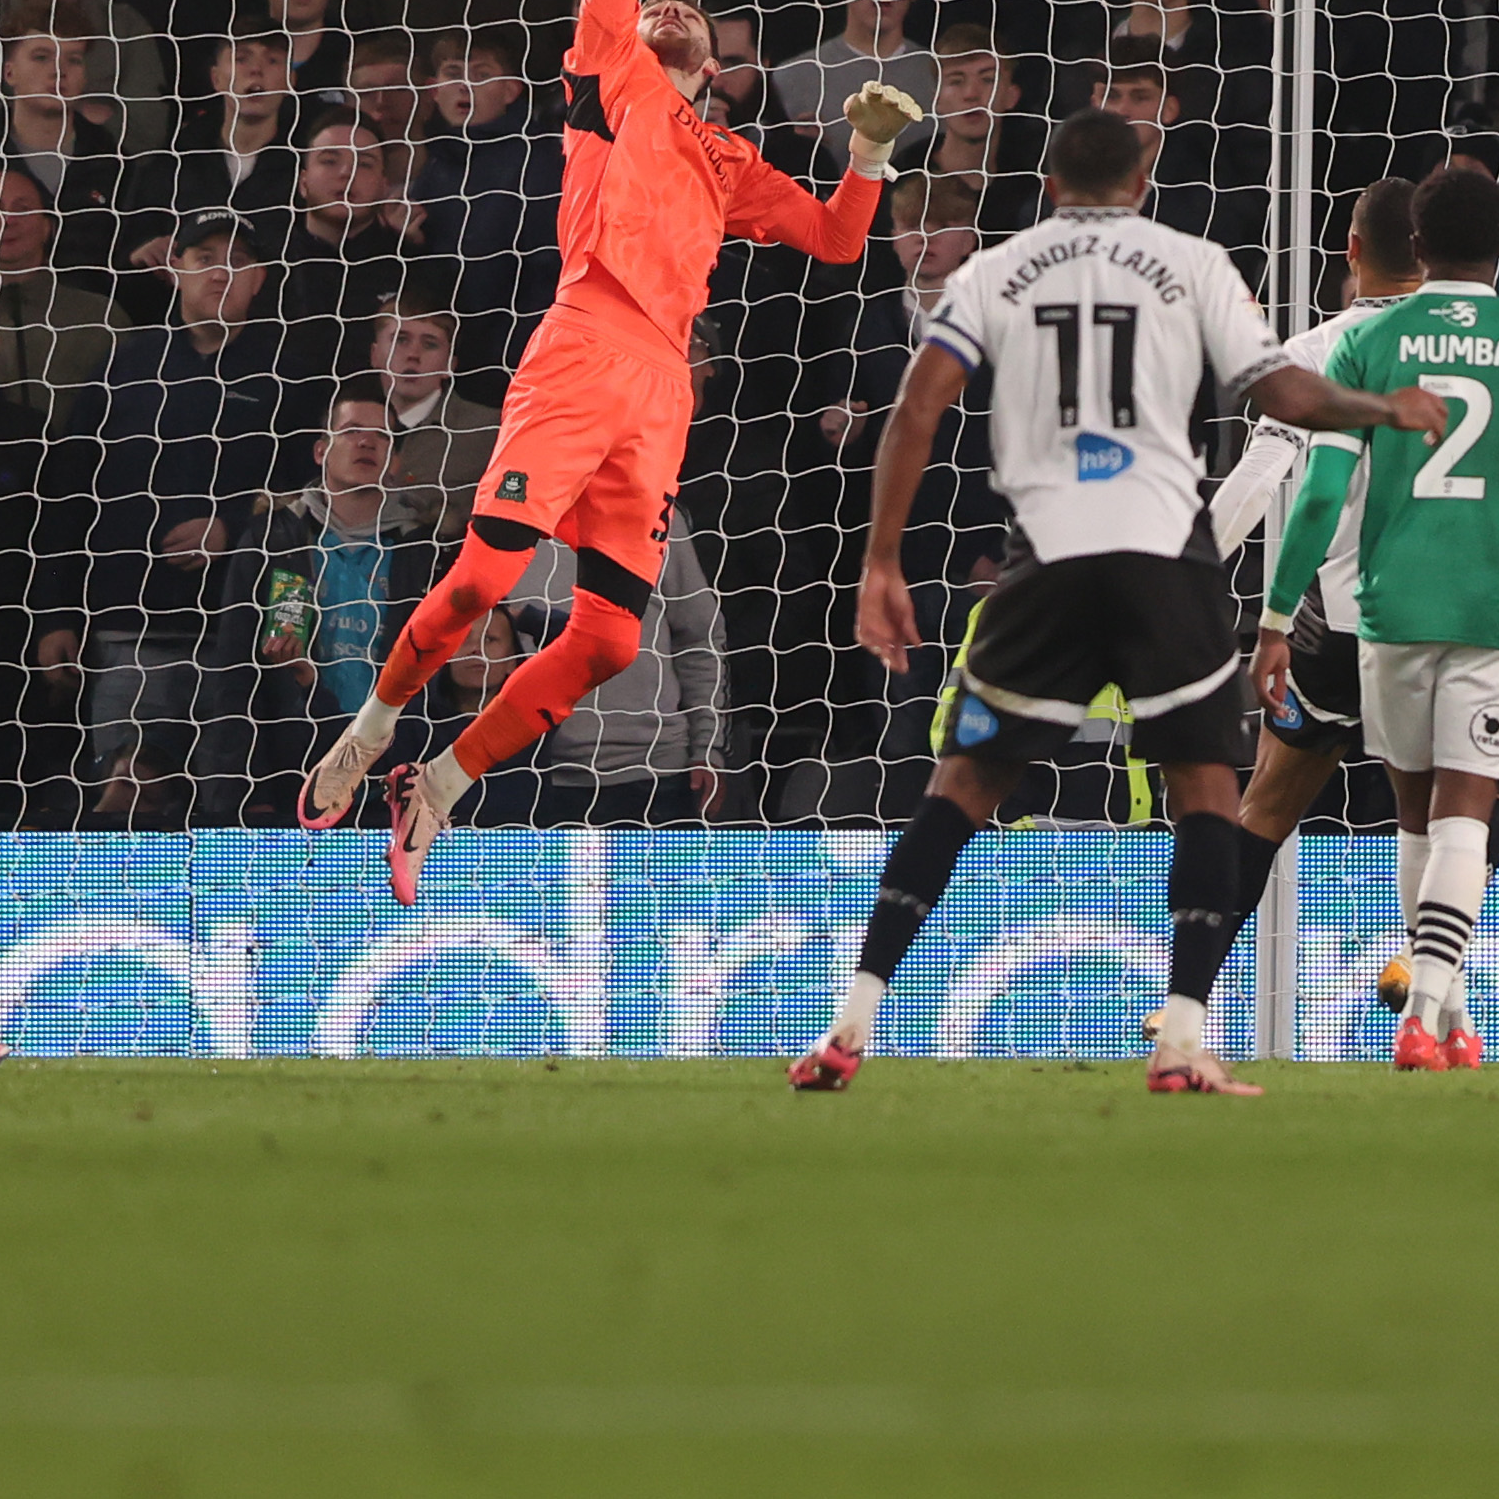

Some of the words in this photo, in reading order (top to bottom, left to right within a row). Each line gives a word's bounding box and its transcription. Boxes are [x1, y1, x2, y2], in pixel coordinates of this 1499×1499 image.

[1000, 233, 1186, 307] MENDEZ-LAING
[1035, 303, 1139, 429] 11
[1412, 373, 1493, 500] 2
